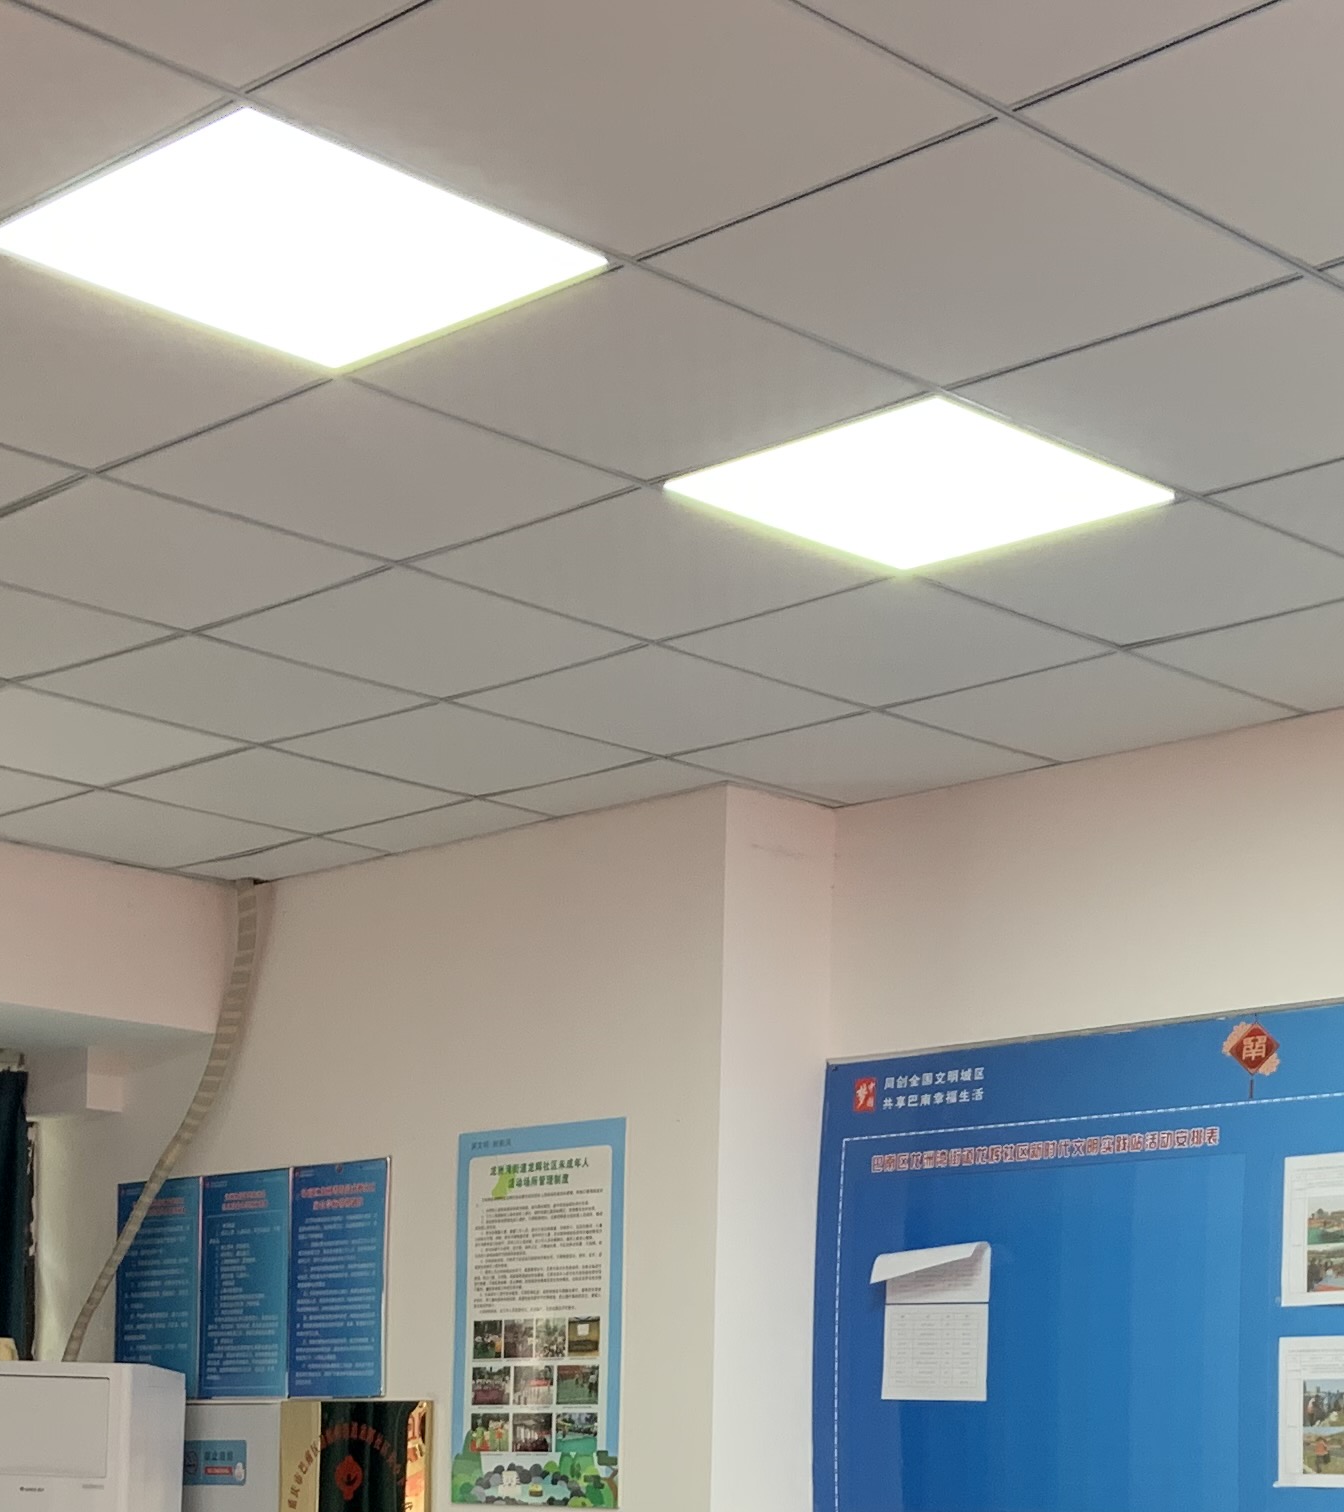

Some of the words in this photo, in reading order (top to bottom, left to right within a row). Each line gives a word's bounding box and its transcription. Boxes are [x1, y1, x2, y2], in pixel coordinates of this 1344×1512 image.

[884, 1067, 985, 1090] 同创全国文明城区
[882, 1088, 984, 1110] 共享巴南幸福生活
